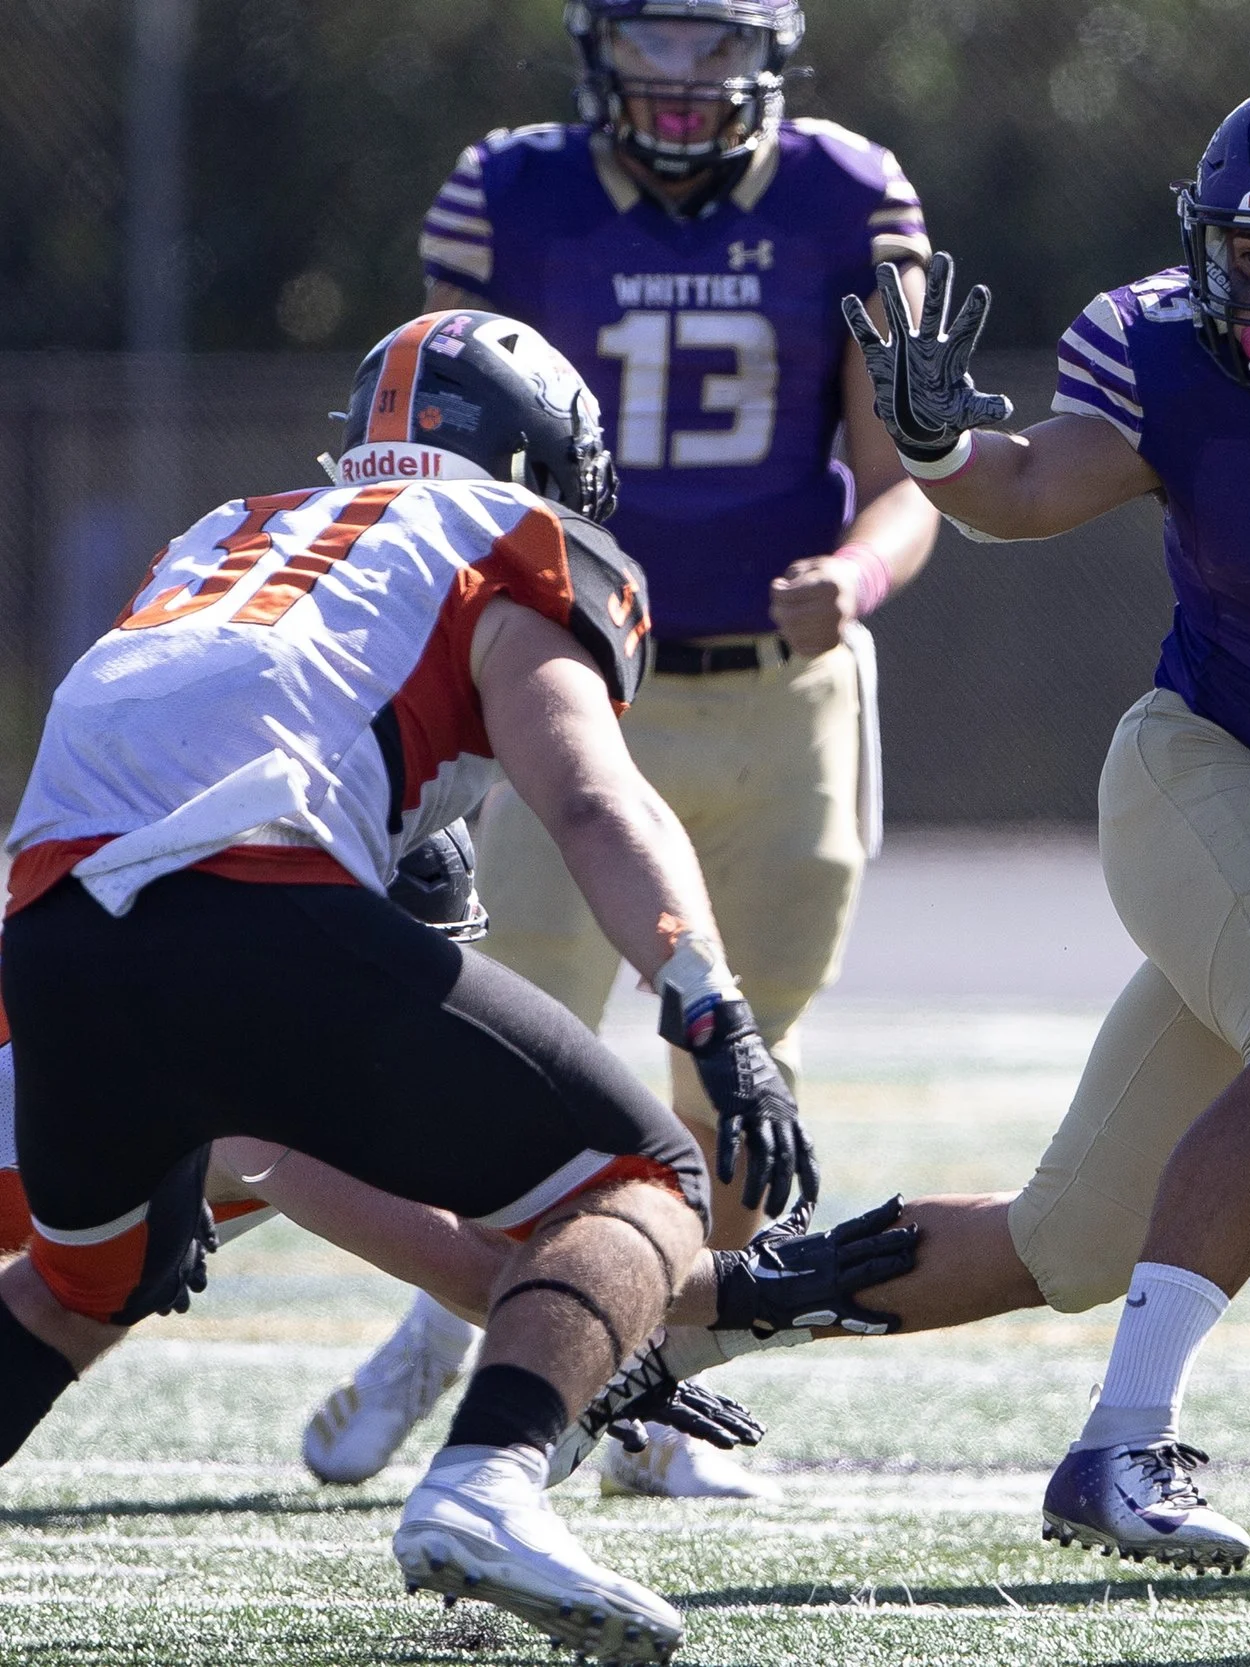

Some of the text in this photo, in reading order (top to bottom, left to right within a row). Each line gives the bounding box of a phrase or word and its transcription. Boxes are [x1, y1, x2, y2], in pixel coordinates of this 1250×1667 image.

[612, 273, 762, 307] WHITTIER
[597, 309, 779, 468] 13
[342, 449, 441, 482] Riddell
